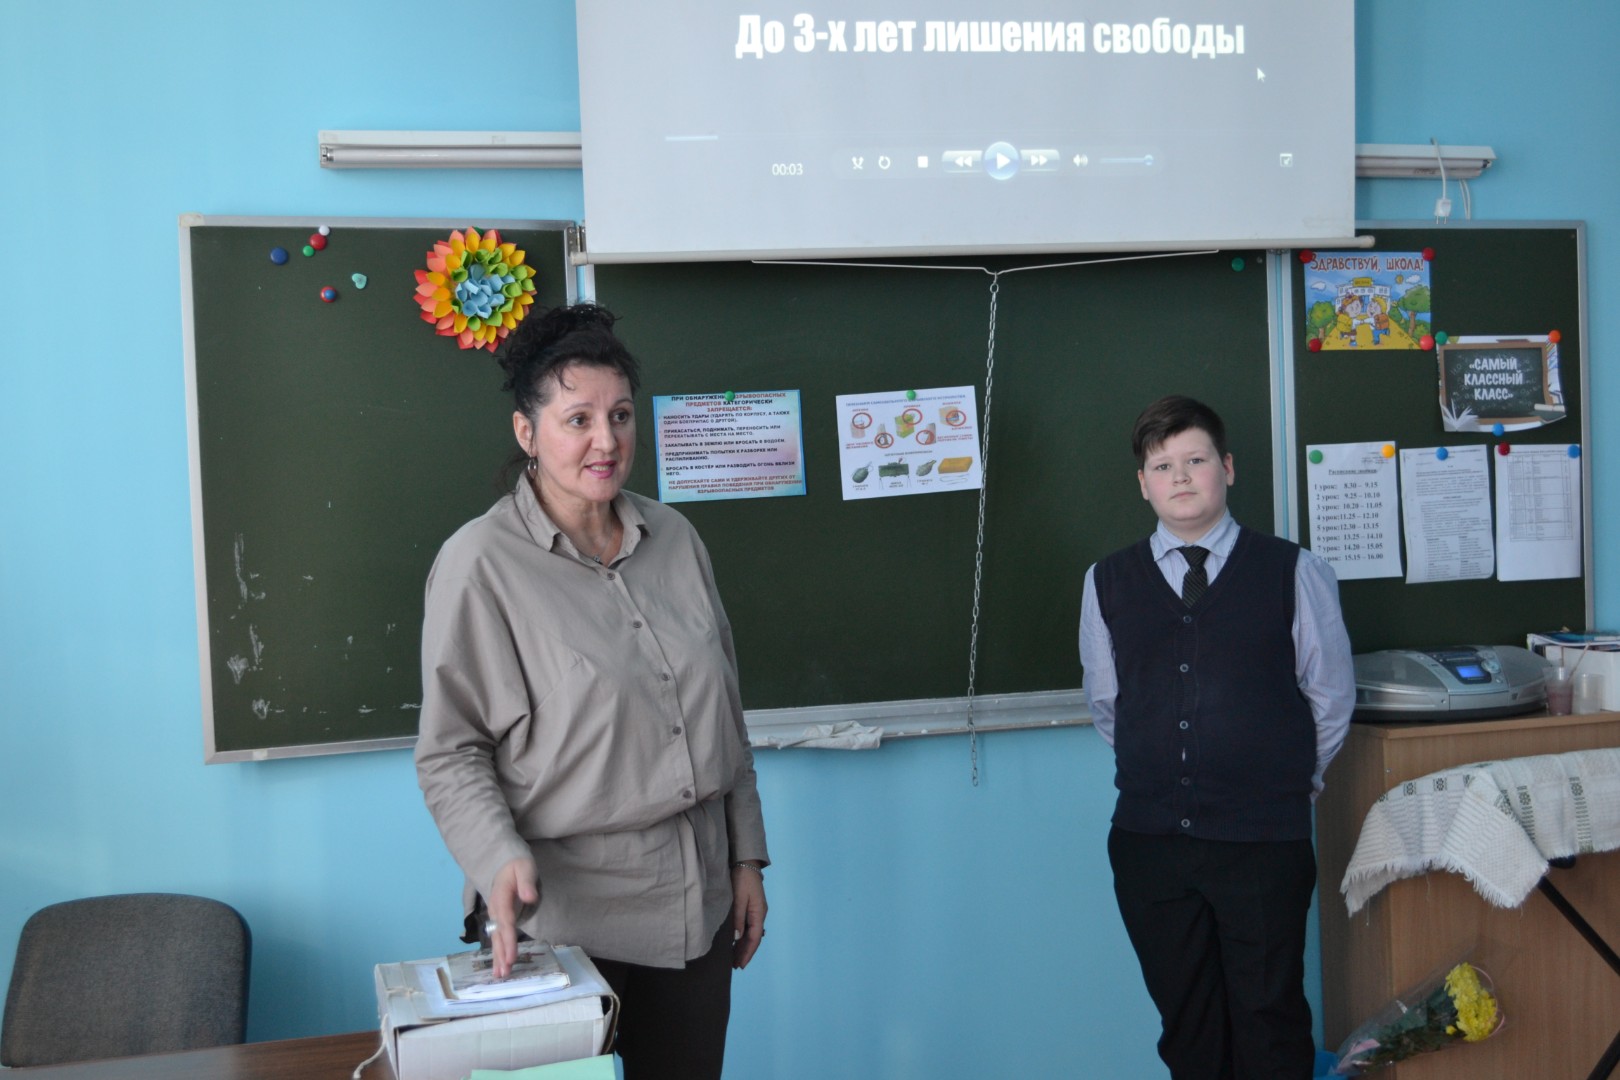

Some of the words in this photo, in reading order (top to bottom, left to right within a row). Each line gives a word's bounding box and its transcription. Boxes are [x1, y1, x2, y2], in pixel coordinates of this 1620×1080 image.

[735, 14, 786, 60] До
[792, 13, 848, 54] 3-х
[852, 20, 917, 54] лет
[922, 20, 1087, 54] лишения
[1092, 18, 1246, 59] свободы
[772, 163, 803, 176] 00:03
[1310, 252, 1381, 272] ЗДРАВСТВУЙ,
[1386, 258, 1425, 271] ШКОЛА!
[1469, 357, 1518, 371] «САМЫЙ
[1464, 369, 1523, 386] КЛАССНЫЙ
[1474, 388, 1514, 401] КЛАСС»
[1364, 481, 1378, 489] 9.15
[1363, 491, 1381, 499] 10.10
[1363, 522, 1380, 530] 13.15
[1343, 533, 1360, 541] 13.25
[1366, 532, 1383, 540] 14.10
[1344, 543, 1360, 551] 14.20
[1367, 542, 1383, 550] 15.05
[1345, 553, 1361, 561] 15.15
